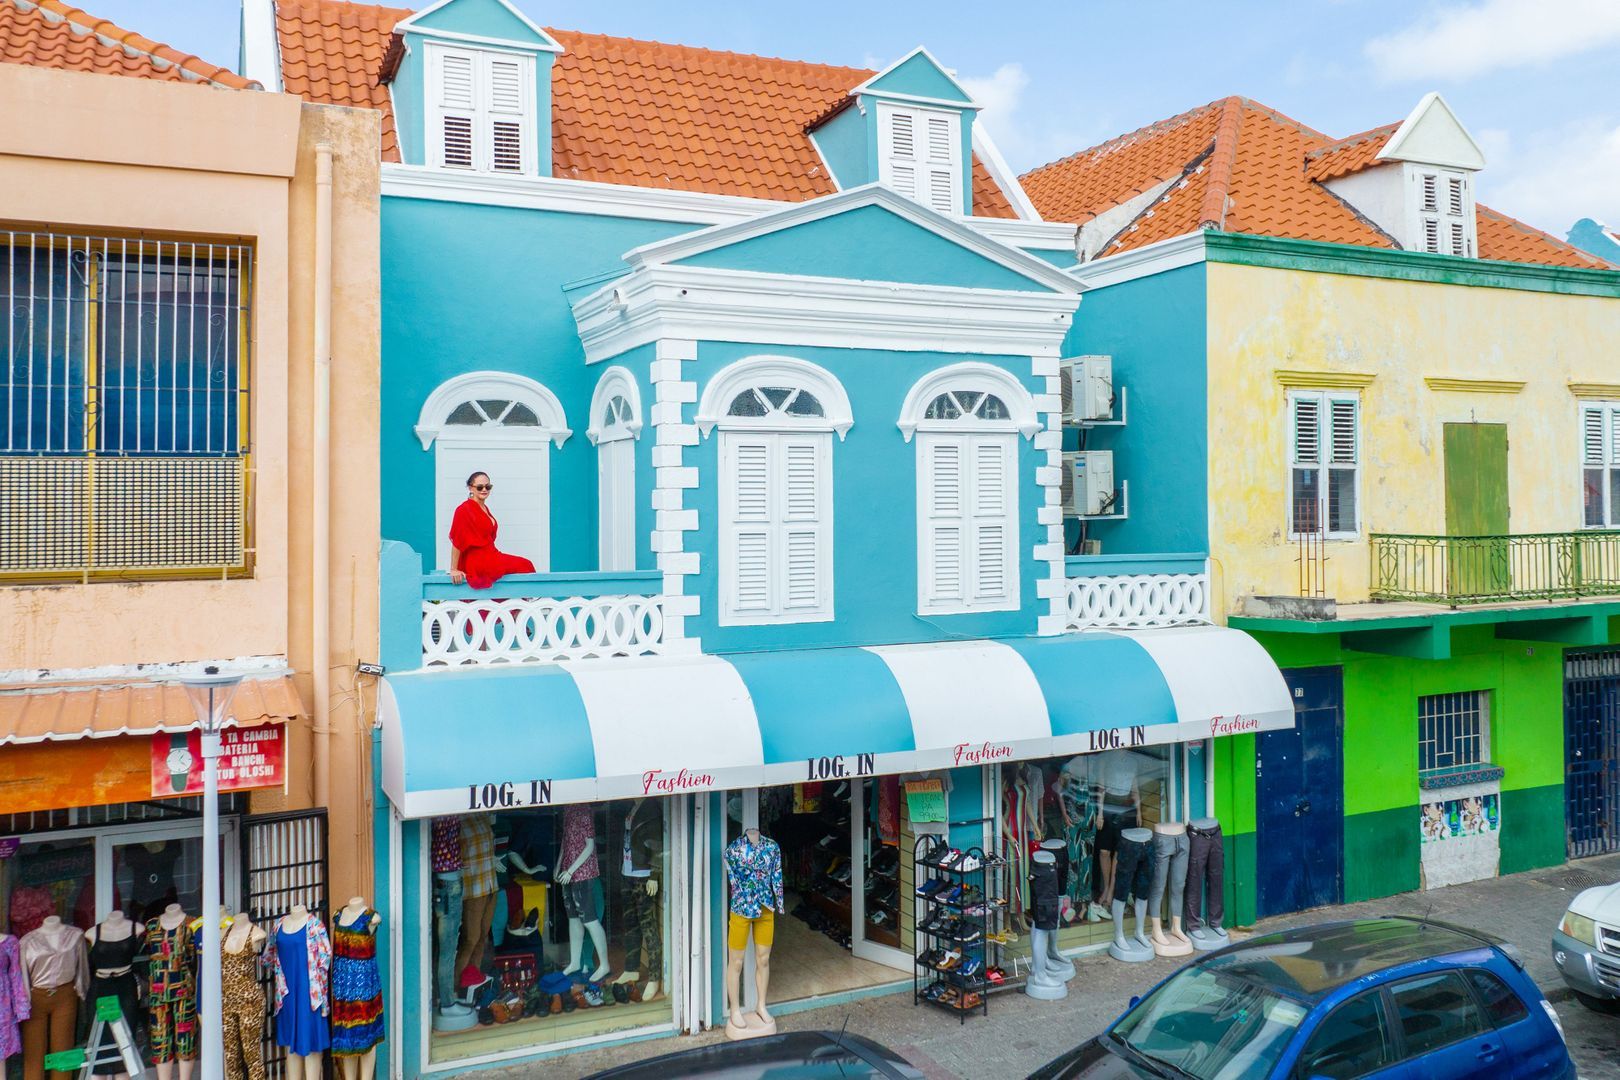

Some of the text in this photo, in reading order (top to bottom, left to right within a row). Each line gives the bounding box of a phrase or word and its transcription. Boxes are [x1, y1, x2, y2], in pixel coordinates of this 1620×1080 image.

[227, 732, 238, 743] TA
[243, 729, 279, 742] CAMBIA
[1130, 725, 1145, 746] IN
[1210, 714, 1259, 736] Fashion
[231, 753, 265, 767] BANCHI
[856, 752, 875, 776] IN
[954, 741, 1013, 766] Fashion
[239, 764, 274, 779] OLOSHI
[642, 768, 716, 795] Fashion
[529, 779, 552, 804] IN
